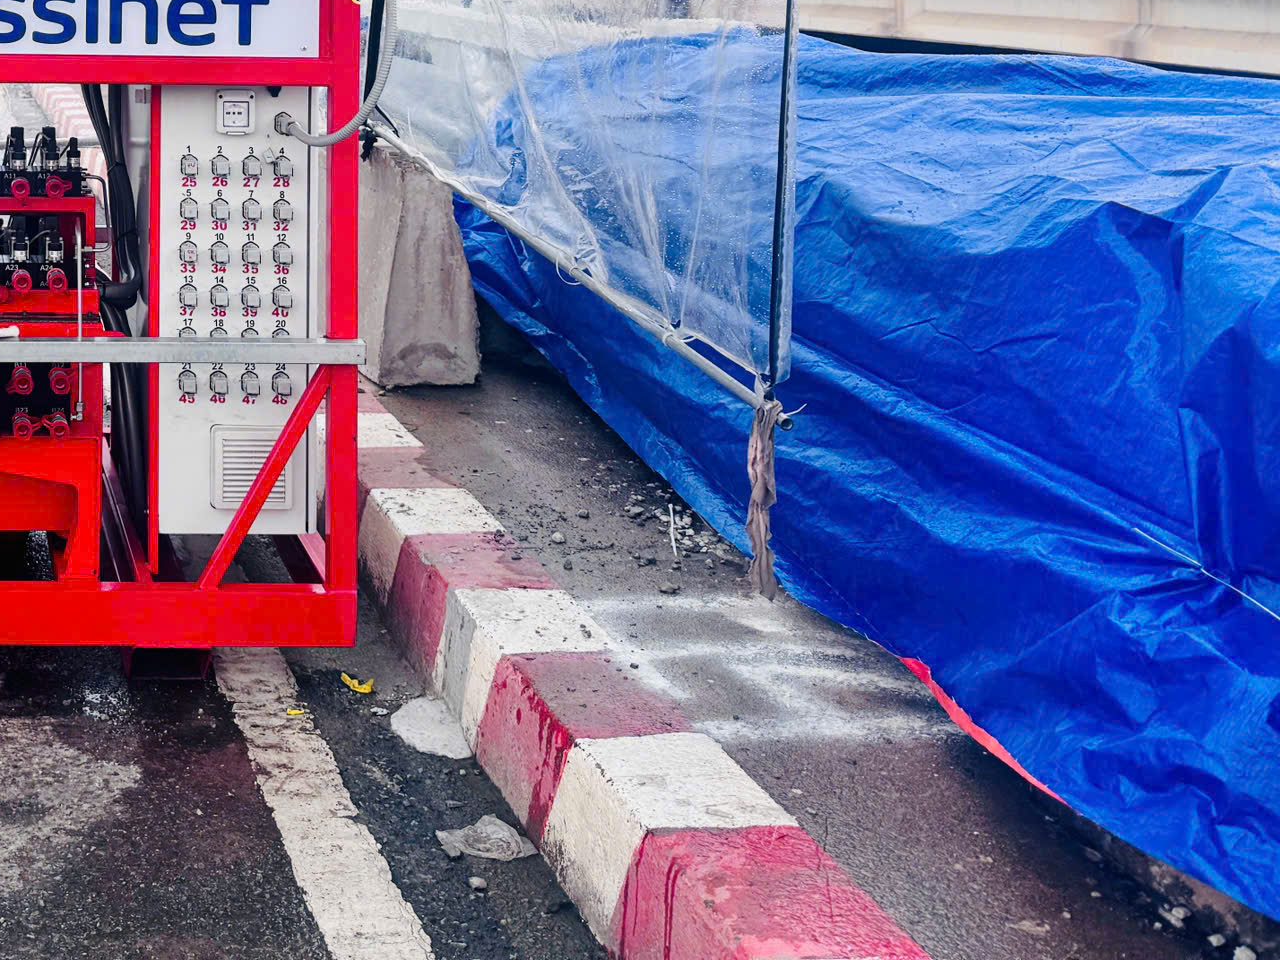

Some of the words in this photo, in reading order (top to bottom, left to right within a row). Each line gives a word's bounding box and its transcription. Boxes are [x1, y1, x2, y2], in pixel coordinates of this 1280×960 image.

[186, 145, 191, 153] 1
[279, 147, 285, 155] 4
[181, 177, 197, 187] 25
[212, 176, 228, 187] 26
[243, 177, 260, 187] 27
[273, 177, 290, 187] 28
[186, 189, 192, 197] 5
[180, 220, 196, 230] 29
[211, 220, 227, 230] 30
[242, 221, 256, 231] 31
[273, 221, 289, 231] 32
[185, 232, 191, 240] 9
[276, 233, 286, 241] 12
[180, 263, 196, 273] 33
[211, 263, 226, 273] 34
[242, 264, 259, 274] 35
[274, 264, 289, 274] 36
[183, 275, 194, 283] 13
[214, 276, 224, 284] 14
[277, 277, 287, 285] 16
[179, 306, 195, 316] 37
[211, 307, 226, 317] 38
[242, 307, 257, 317] 39
[183, 318, 193, 326] 17
[214, 319, 224, 327] 18
[275, 320, 286, 328] 20
[275, 363, 286, 371] 24
